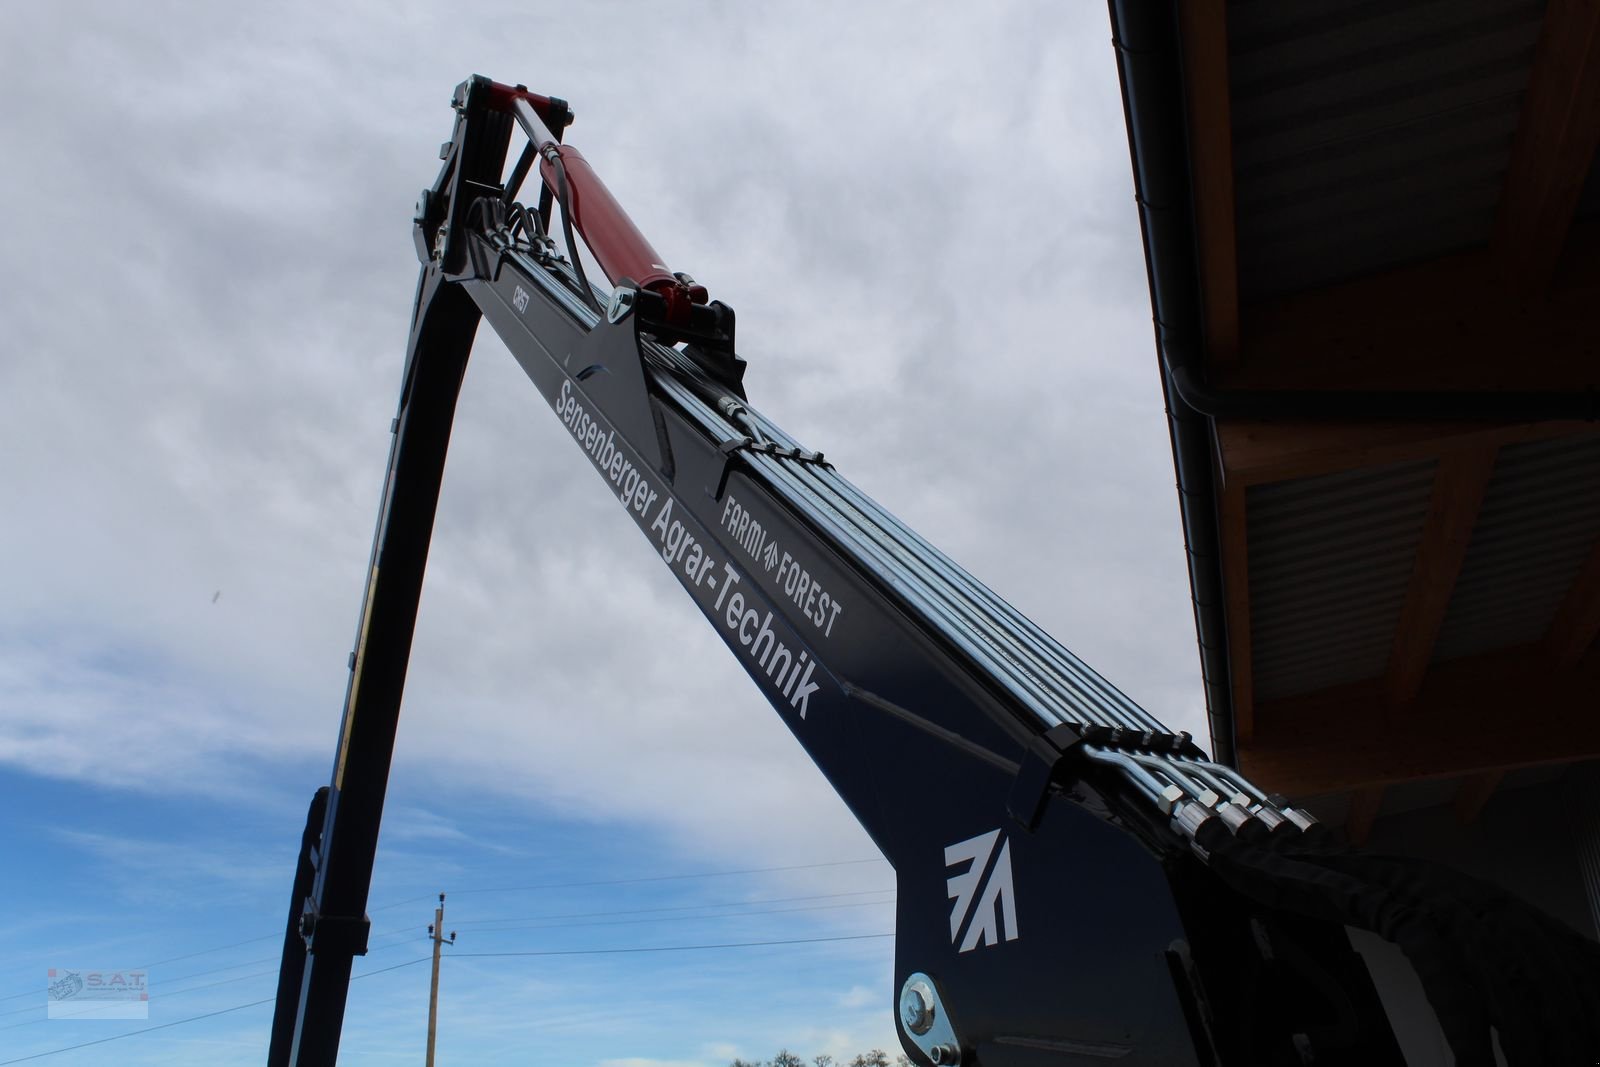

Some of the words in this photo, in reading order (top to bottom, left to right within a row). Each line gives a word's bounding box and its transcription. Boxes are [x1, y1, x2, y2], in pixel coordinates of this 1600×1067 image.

[556, 379, 657, 518] Sensenberger
[652, 497, 820, 720] Agrar-Technik
[721, 495, 767, 562] FARMI
[775, 551, 842, 639] FOREST
